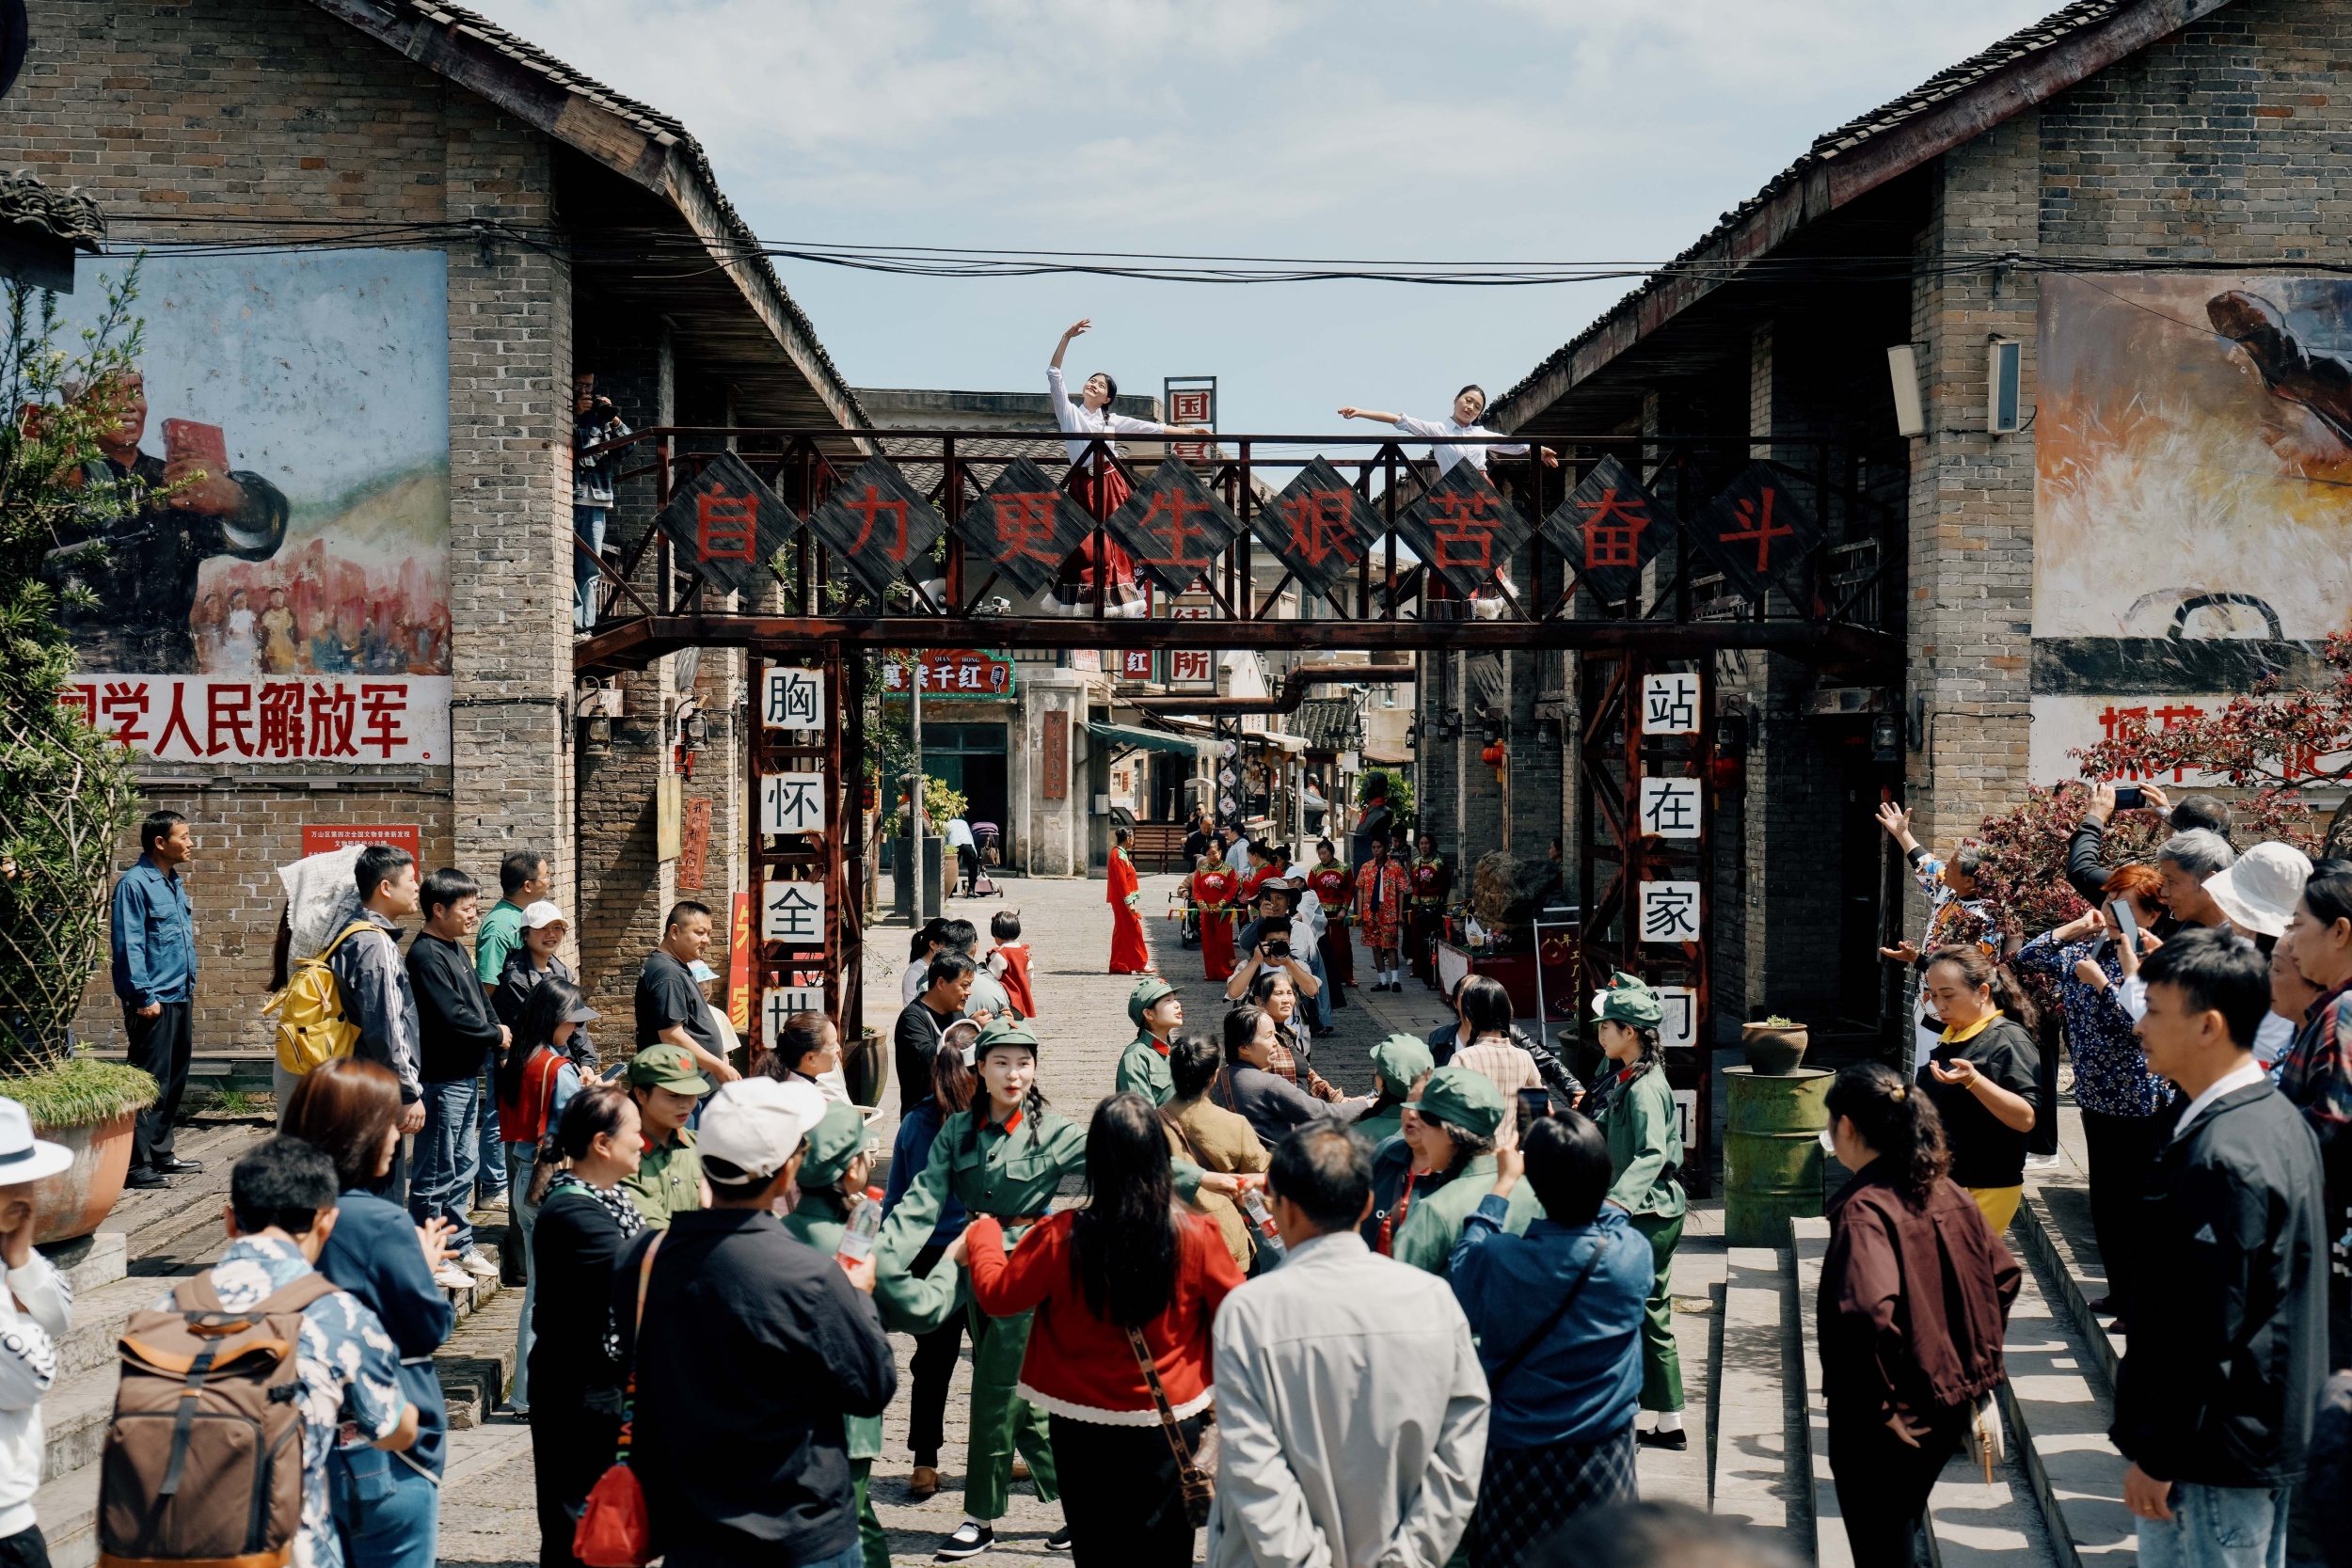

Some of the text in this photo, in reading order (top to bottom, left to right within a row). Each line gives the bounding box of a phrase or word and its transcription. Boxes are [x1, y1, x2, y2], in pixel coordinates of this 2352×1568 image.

[696, 483, 1793, 572] 自力更生艰苦奋斗
